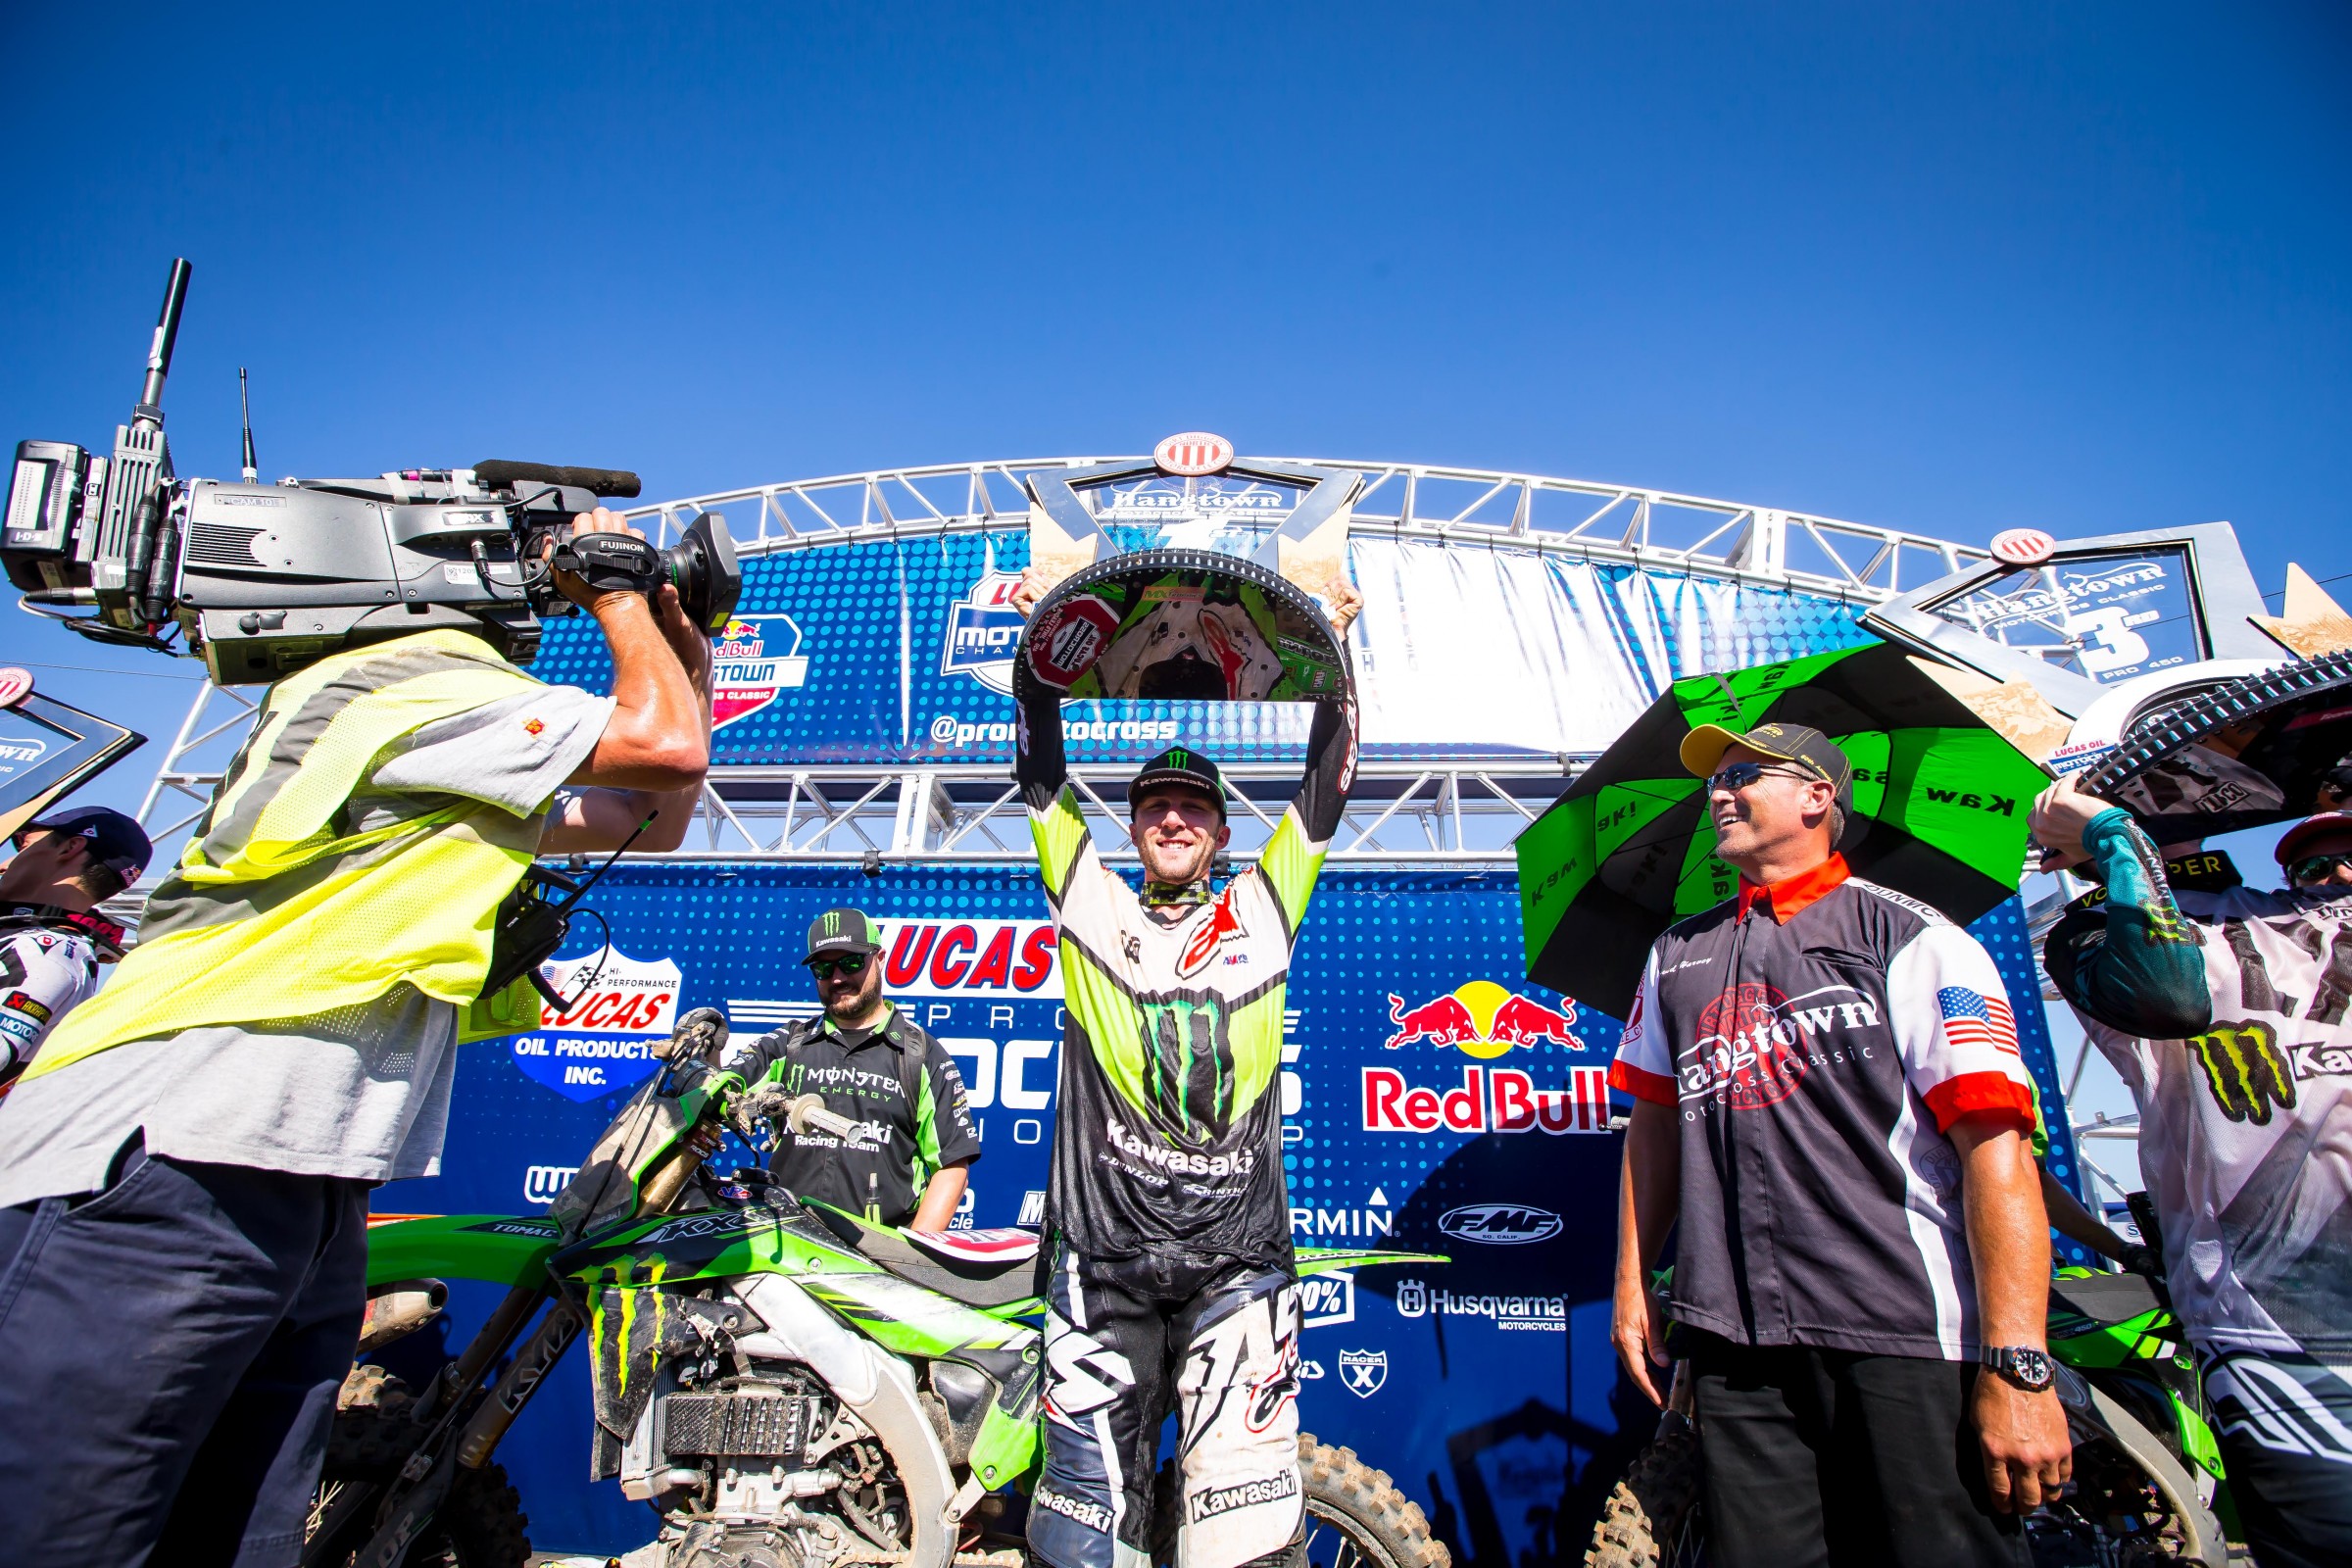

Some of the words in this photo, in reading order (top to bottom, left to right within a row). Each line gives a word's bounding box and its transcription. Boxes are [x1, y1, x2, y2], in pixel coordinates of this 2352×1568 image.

[1110, 485, 1282, 511] Hangtown
[600, 540, 644, 553] FUJINON
[1974, 563, 2168, 621] Hangtown
[2097, 584, 2165, 605] CLASSIC
[729, 641, 762, 657] Bull
[713, 664, 775, 681] TOWN
[2102, 666, 2139, 679] PRO
[2148, 656, 2183, 669] 450
[727, 691, 770, 700] CLASSIC
[2055, 744, 2086, 758] LUCAS
[2088, 739, 2106, 749] OIL
[1140, 777, 1210, 790] Kawasaki
[815, 934, 852, 948] Kawasaki
[875, 924, 1058, 993] UCAS
[609, 967, 622, 976] HI-
[607, 978, 677, 989] PERFORMANCE
[514, 1037, 550, 1056] OIL
[564, 1066, 607, 1085] INC.
[819, 1086, 892, 1102] ENERGY
[1362, 1065, 1486, 1133] Red
[1489, 1066, 1612, 1135] Bull
[795, 1135, 839, 1149] Racing
[1106, 1118, 1254, 1177] Kawasaki
[1108, 1157, 1169, 1187] DUNLOP
[1289, 1208, 1393, 1237] RMIN
[1441, 1209, 1560, 1233] FMF
[492, 1223, 558, 1239] TOMAC
[1430, 1289, 1565, 1319] Husqvarna
[1498, 1322, 1566, 1331] MOTORCYCLES
[1351, 1365, 1376, 1388] X
[1193, 1473, 1297, 1520] Kawasaki
